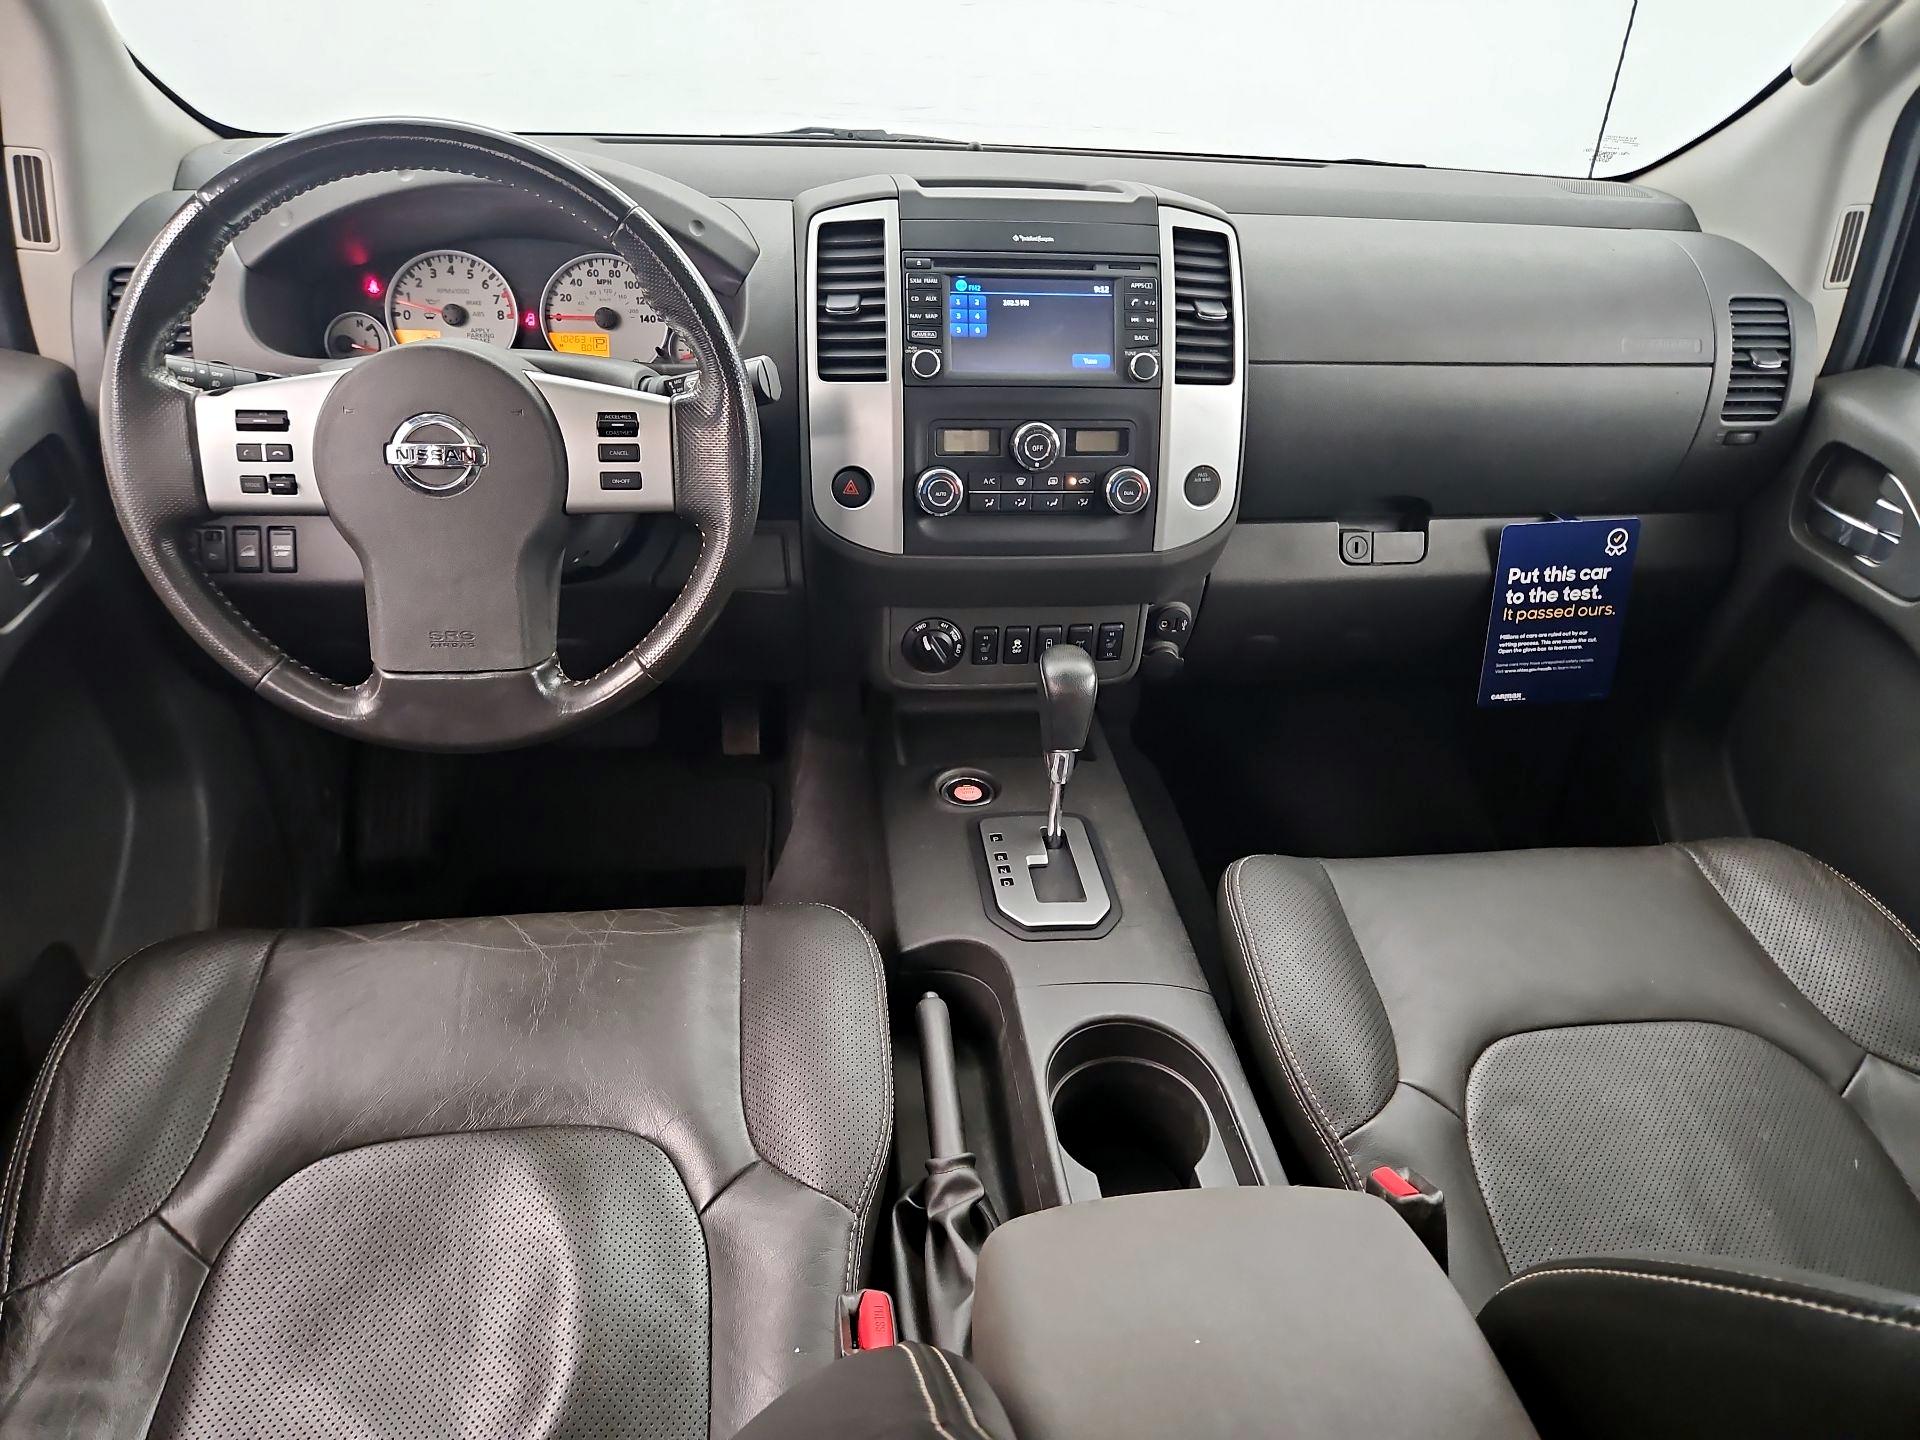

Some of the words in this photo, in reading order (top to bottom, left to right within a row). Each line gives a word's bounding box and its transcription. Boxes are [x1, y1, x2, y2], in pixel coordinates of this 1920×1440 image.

[430, 268, 437, 279] 3
[446, 265, 454, 275] 4
[467, 269, 474, 280] 5
[587, 270, 599, 278] 60
[609, 270, 621, 278] 80
[415, 278, 422, 288] 2
[481, 280, 489, 290] 6
[570, 279, 582, 287] 40
[624, 281, 640, 290] 100
[492, 295, 500, 304] 7
[560, 293, 572, 302] 20
[403, 310, 411, 320] 0
[497, 310, 505, 320] 8
[640, 315, 656, 323] 140
[396, 449, 477, 461] NISSAN
[1508, 567, 1540, 585] Put
[1543, 565, 1576, 582] this
[1579, 567, 1612, 581] car
[1505, 589, 1525, 605] to
[1528, 586, 1559, 604] the
[1562, 584, 1603, 602] test.
[1503, 607, 1514, 622] It
[1515, 604, 1575, 625] passed
[1577, 605, 1616, 617] ours.
[429, 630, 476, 640] SRS
